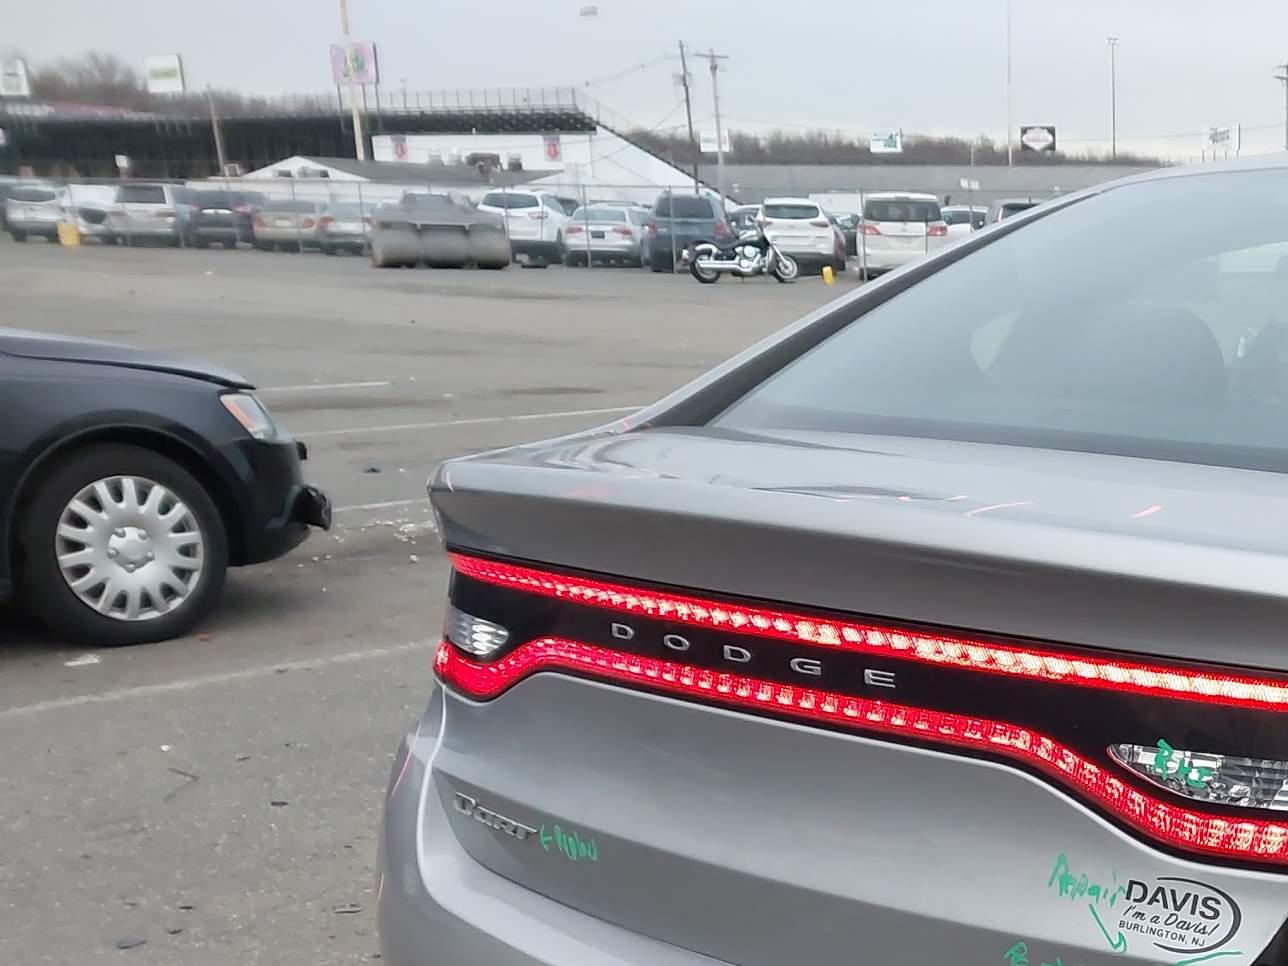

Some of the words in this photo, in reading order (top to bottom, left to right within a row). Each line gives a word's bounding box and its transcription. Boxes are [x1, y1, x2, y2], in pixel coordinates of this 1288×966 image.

[611, 622, 897, 689] DODGE
[1125, 879, 1222, 921] DAVIS
[1118, 919, 1189, 944] BURLINGTON,
[1191, 936, 1206, 947] NJ
[1123, 904, 1146, 921] I'm
[1149, 914, 1161, 925] a
[1163, 912, 1220, 936] Davis!
